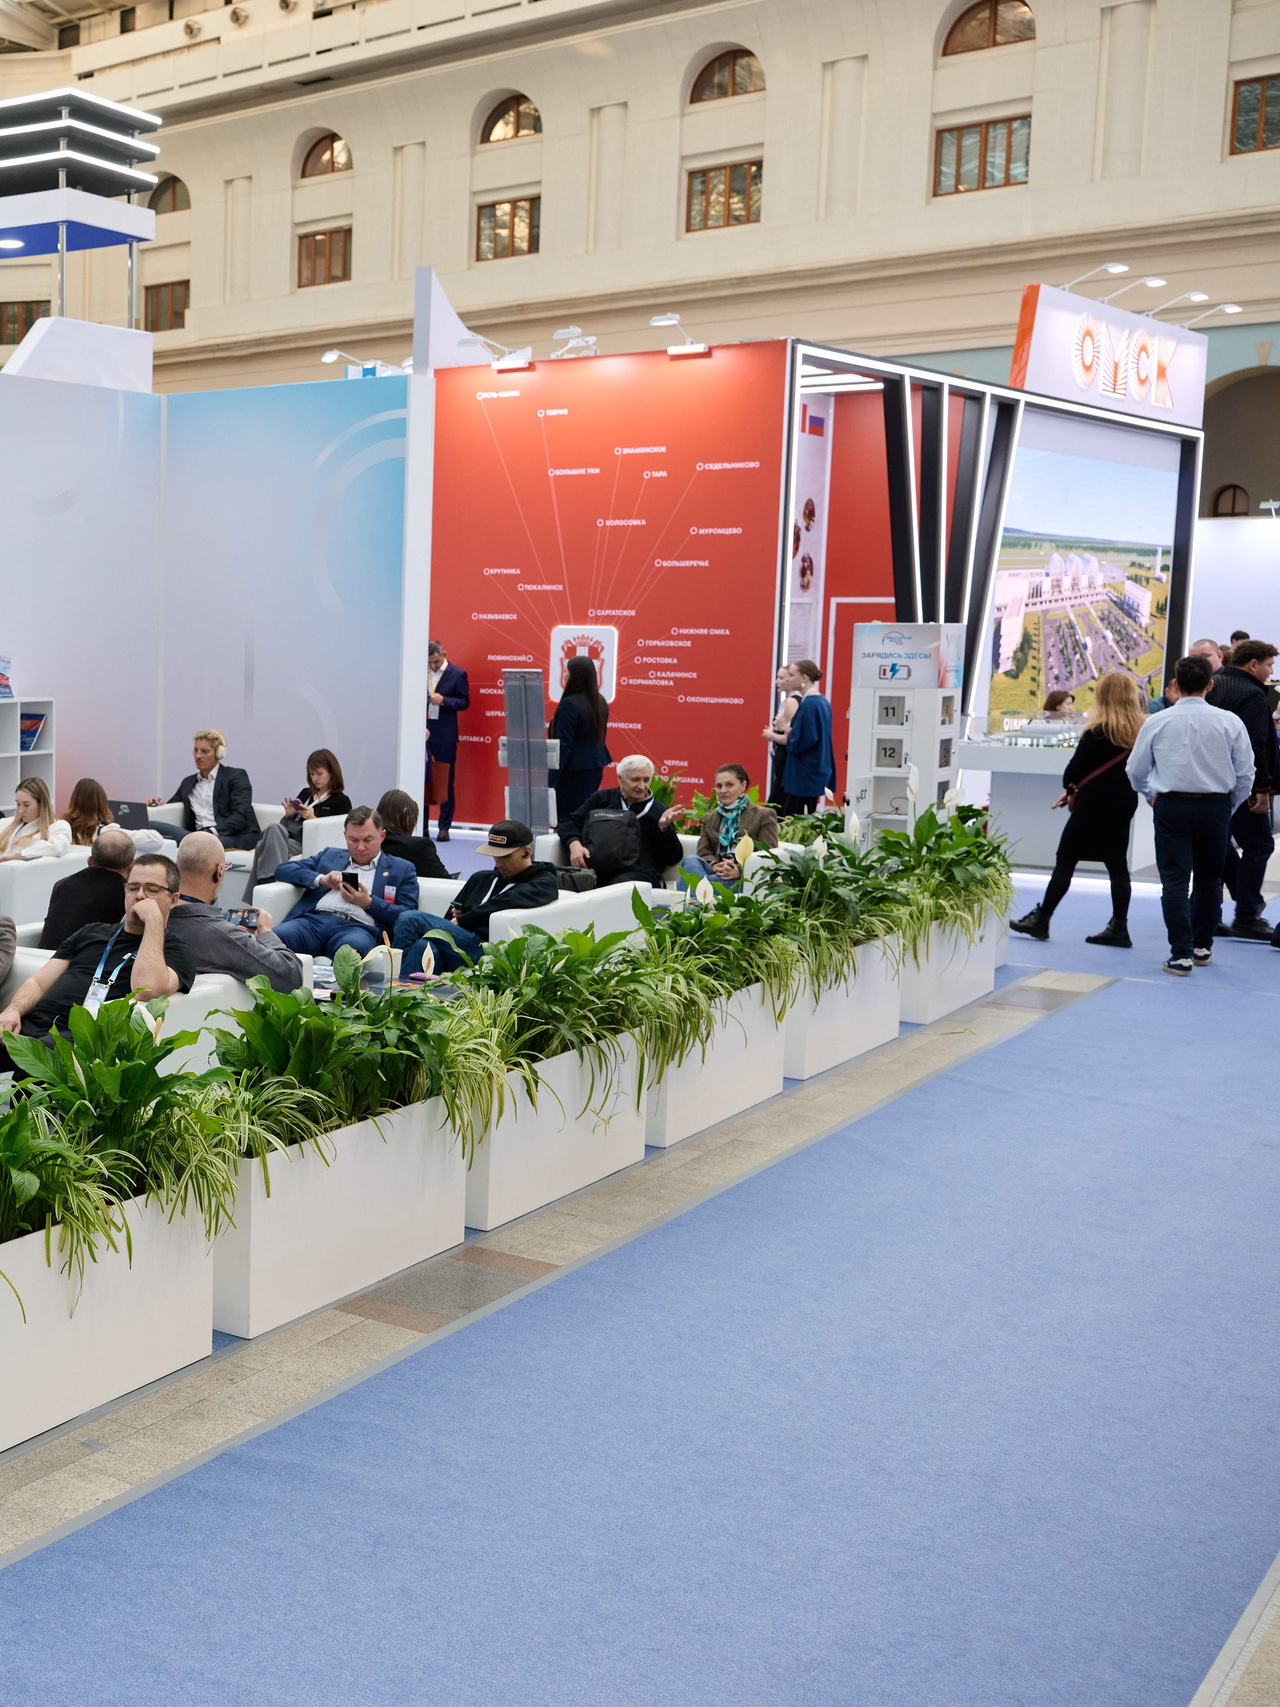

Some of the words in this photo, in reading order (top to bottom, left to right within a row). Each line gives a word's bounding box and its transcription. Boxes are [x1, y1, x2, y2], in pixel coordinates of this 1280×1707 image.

[1072, 313, 1178, 409] ОМСК
[622, 446, 666, 454] ЗНАМЕНСКОЕ
[704, 461, 760, 470] СЕДЕЛЬНИКОВО
[587, 467, 600, 475] УКИ
[699, 527, 742, 536] МУРОМЦЕВО
[686, 696, 744, 704] ОКОНЕШНИКОВО
[883, 706, 896, 717] 11
[882, 747, 896, 758] 12
